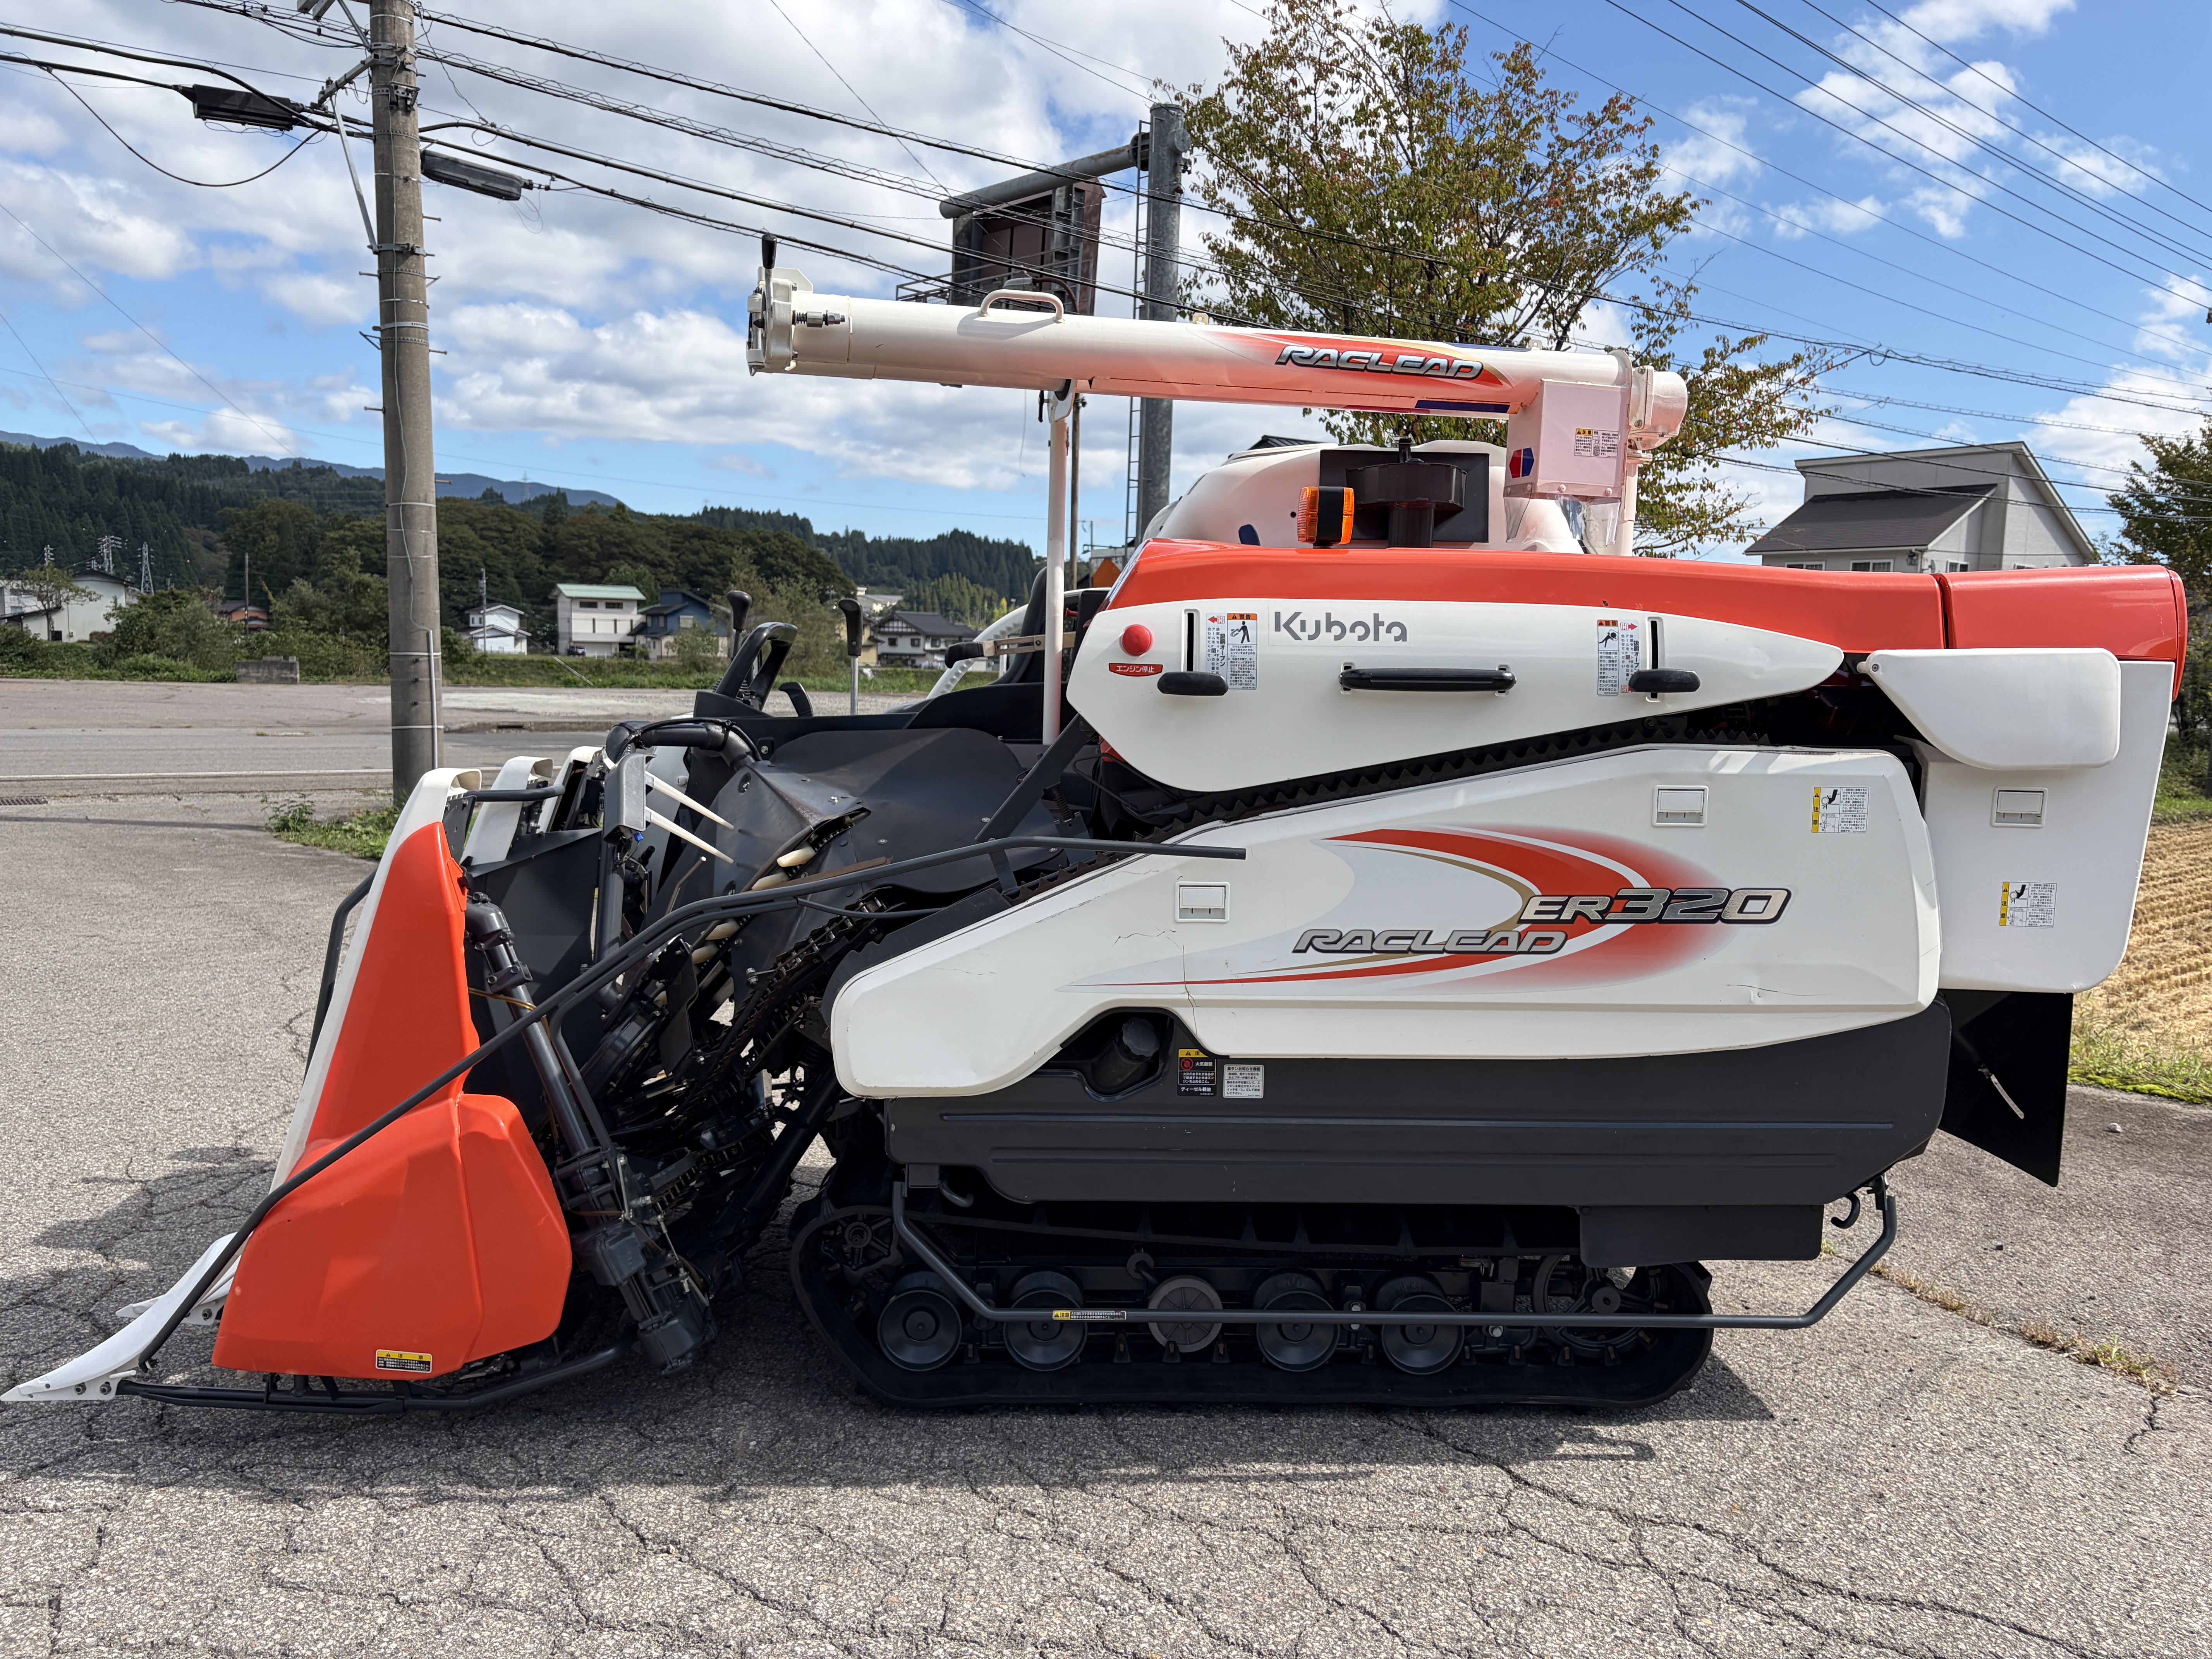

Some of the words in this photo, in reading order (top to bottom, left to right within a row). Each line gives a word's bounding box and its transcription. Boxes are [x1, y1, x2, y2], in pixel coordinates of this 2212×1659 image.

[1275, 346, 1484, 380] RACLEAD
[1274, 611, 1407, 642] Kubota
[1516, 888, 1792, 924] ER320
[1292, 929, 1568, 954] RACLEAD
